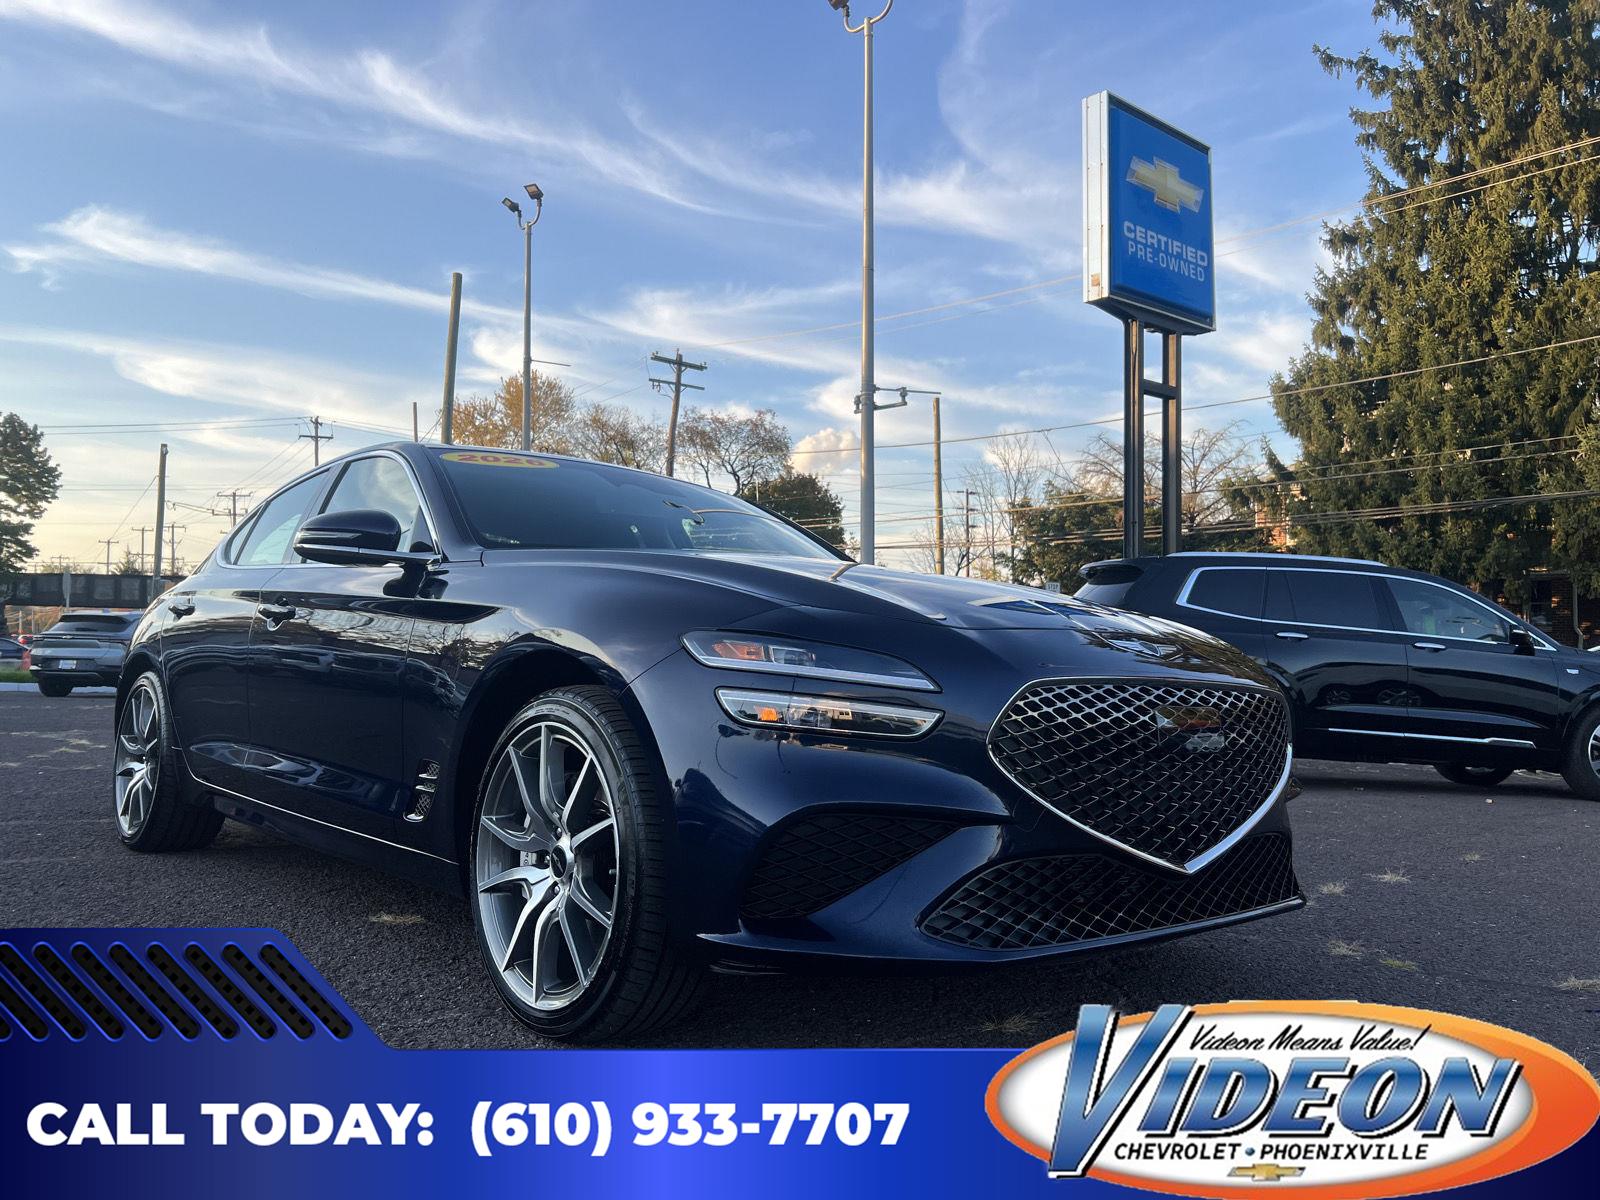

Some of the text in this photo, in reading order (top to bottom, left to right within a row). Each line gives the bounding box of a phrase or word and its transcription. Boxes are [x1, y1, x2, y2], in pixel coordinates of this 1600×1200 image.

[1123, 221, 1208, 267] CERTIFIED
[1128, 241, 1205, 282] PRE-OWNED
[457, 454, 545, 466] 2026
